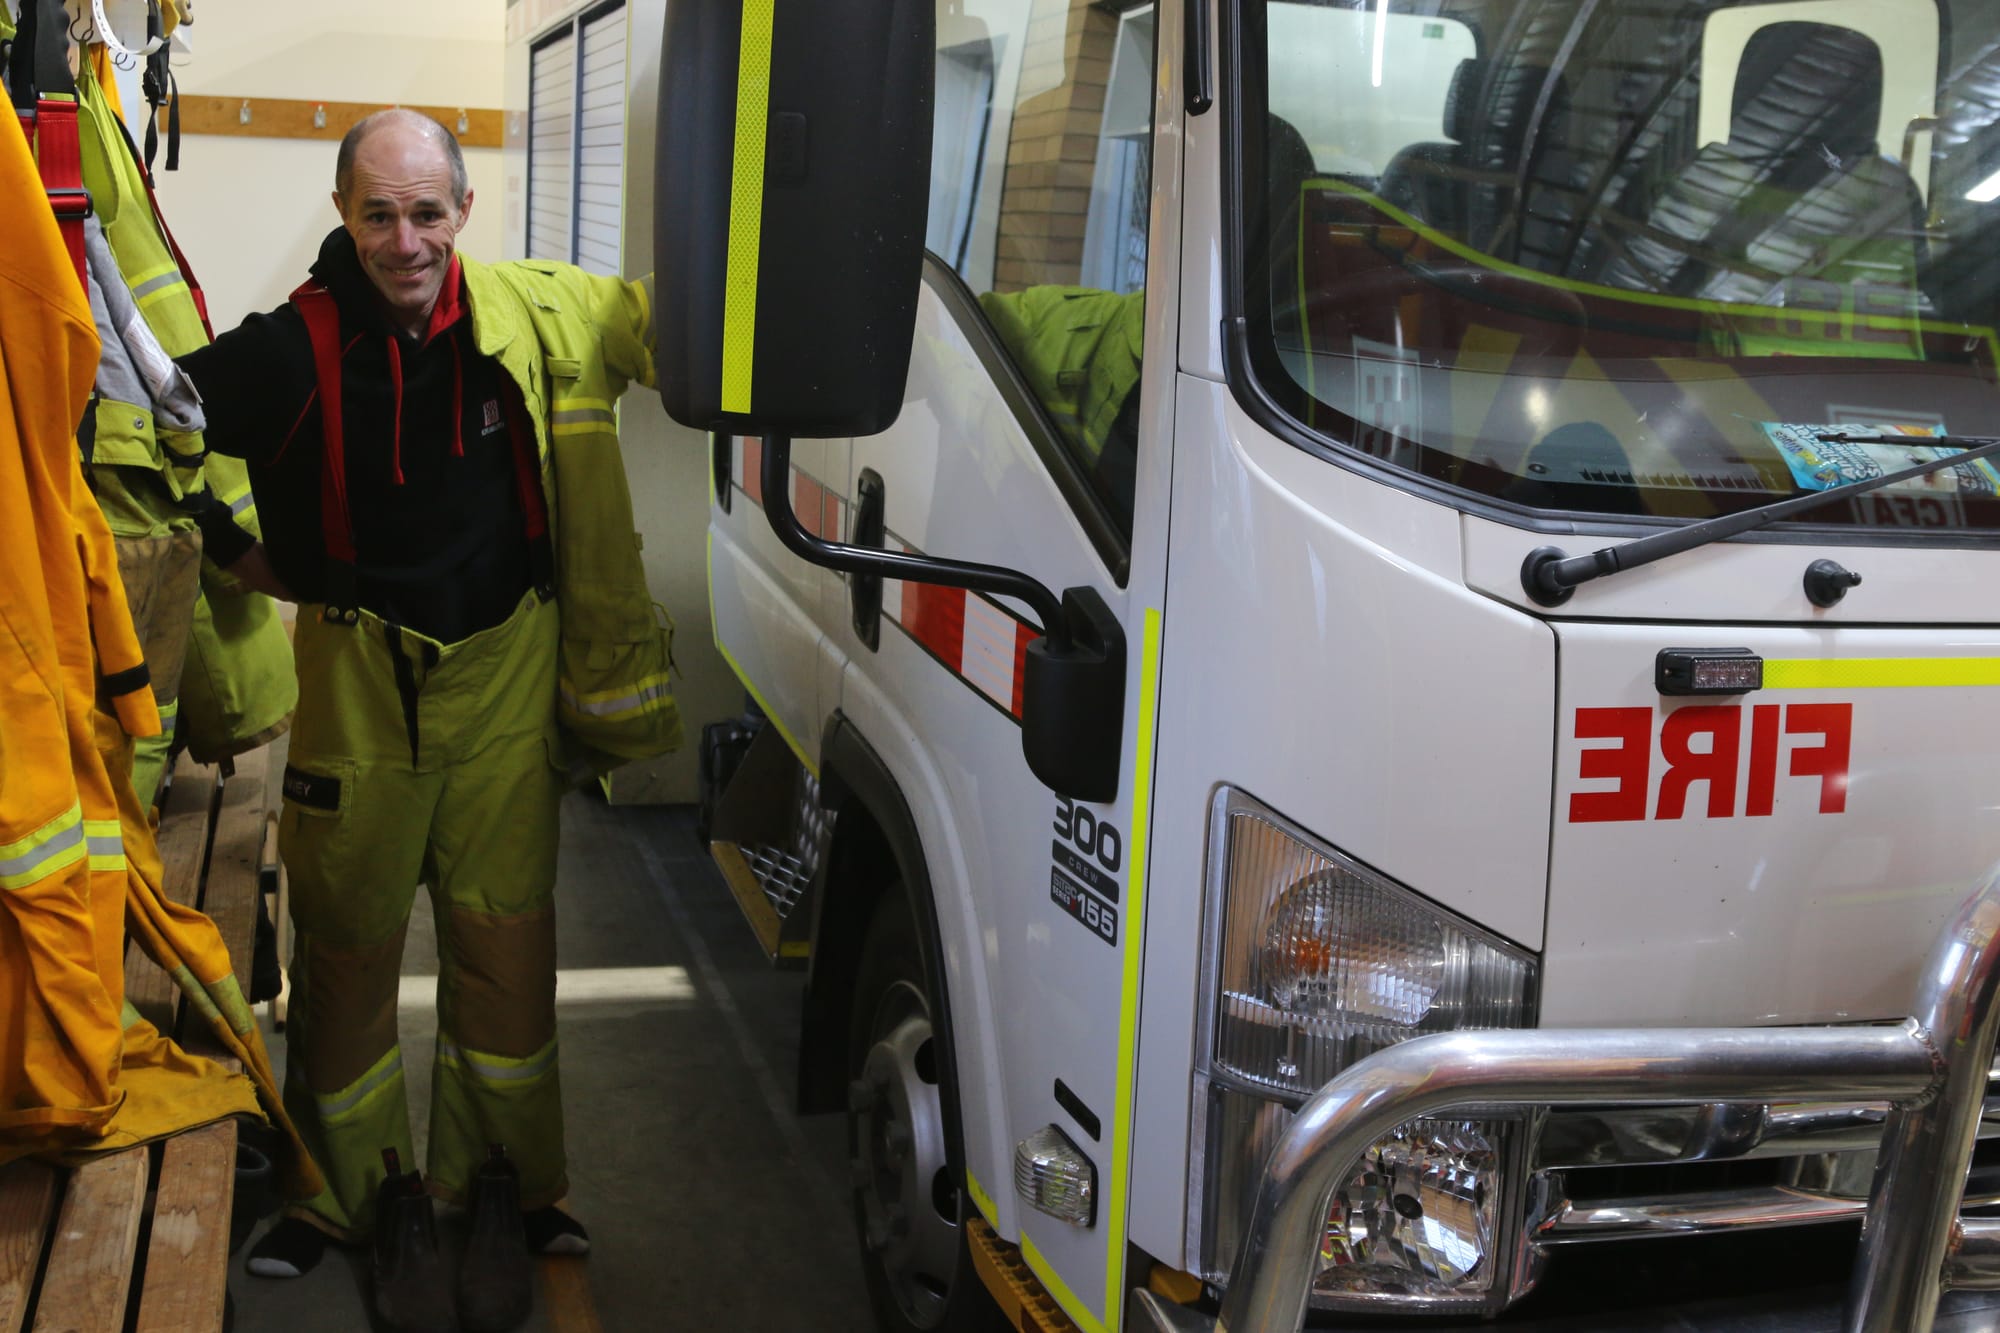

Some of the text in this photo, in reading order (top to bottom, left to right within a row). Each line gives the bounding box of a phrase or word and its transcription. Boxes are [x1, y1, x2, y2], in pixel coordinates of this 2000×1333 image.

[1053, 792, 1122, 873] 300
[1068, 856, 1099, 884] CREW
[1077, 892, 1115, 938] 155
